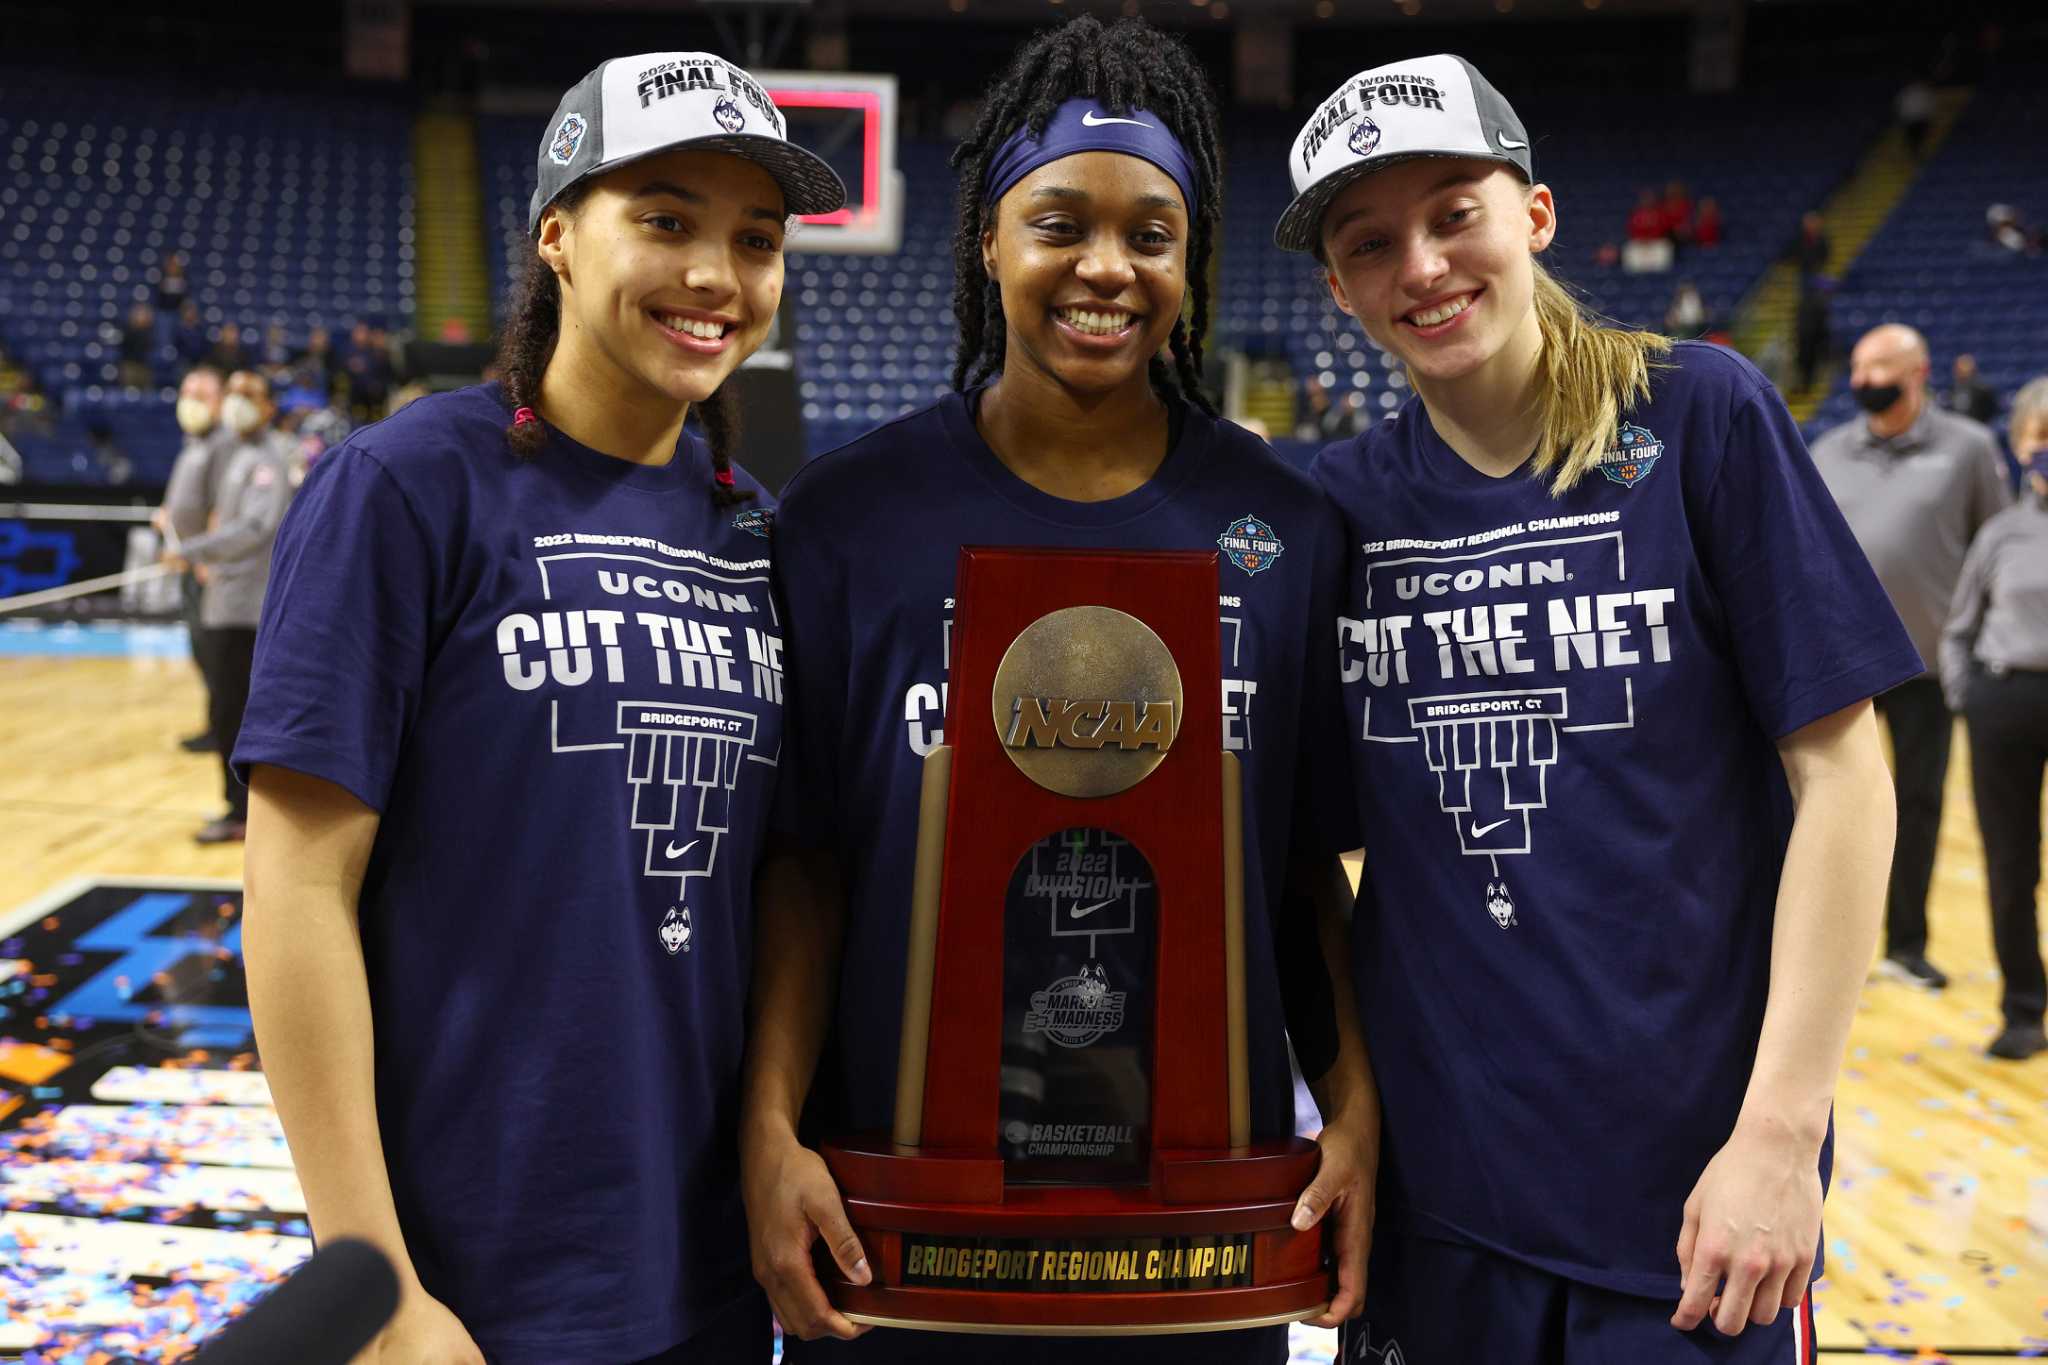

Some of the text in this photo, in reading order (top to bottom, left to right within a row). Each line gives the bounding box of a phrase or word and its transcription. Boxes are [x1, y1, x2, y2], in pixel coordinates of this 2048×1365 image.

[638, 59, 725, 81] 2022 NCAA
[1358, 74, 1436, 88] WOMEN'S
[637, 67, 726, 109] FINAL
[1302, 83, 1445, 174] FINAL FOUR
[1630, 444, 1659, 460] FOUR
[1223, 536, 1251, 551] FINAL
[1252, 539, 1278, 553] FOUR
[1362, 509, 1621, 555] 022 BRIDGEPORT REGIONAL CHAMPIONS
[533, 533, 772, 573] 2022 BRIDGEPORT REGIONAL CHAMPION
[597, 570, 753, 614] UCONN
[1394, 557, 1566, 601] UCONN
[1336, 587, 1676, 688] CUT THE NET
[496, 609, 784, 706] CUT THE NE
[639, 711, 743, 733] BRIDGEPORT, CT
[1221, 679, 1258, 751] ET
[1425, 697, 1543, 717] BRIDGEPORT, CT
[1004, 695, 1178, 753] NCAA
[1023, 873, 1126, 900] DIVISION
[1046, 993, 1106, 1010] MAR
[1051, 1010, 1123, 1026] MADNESS
[1027, 1142, 1116, 1157] CHAMPIONSHIP
[1030, 1123, 1134, 1144] BASKETBALL
[906, 1244, 1249, 1282] BRIDGEPORT REGIONAL CHAMPION
